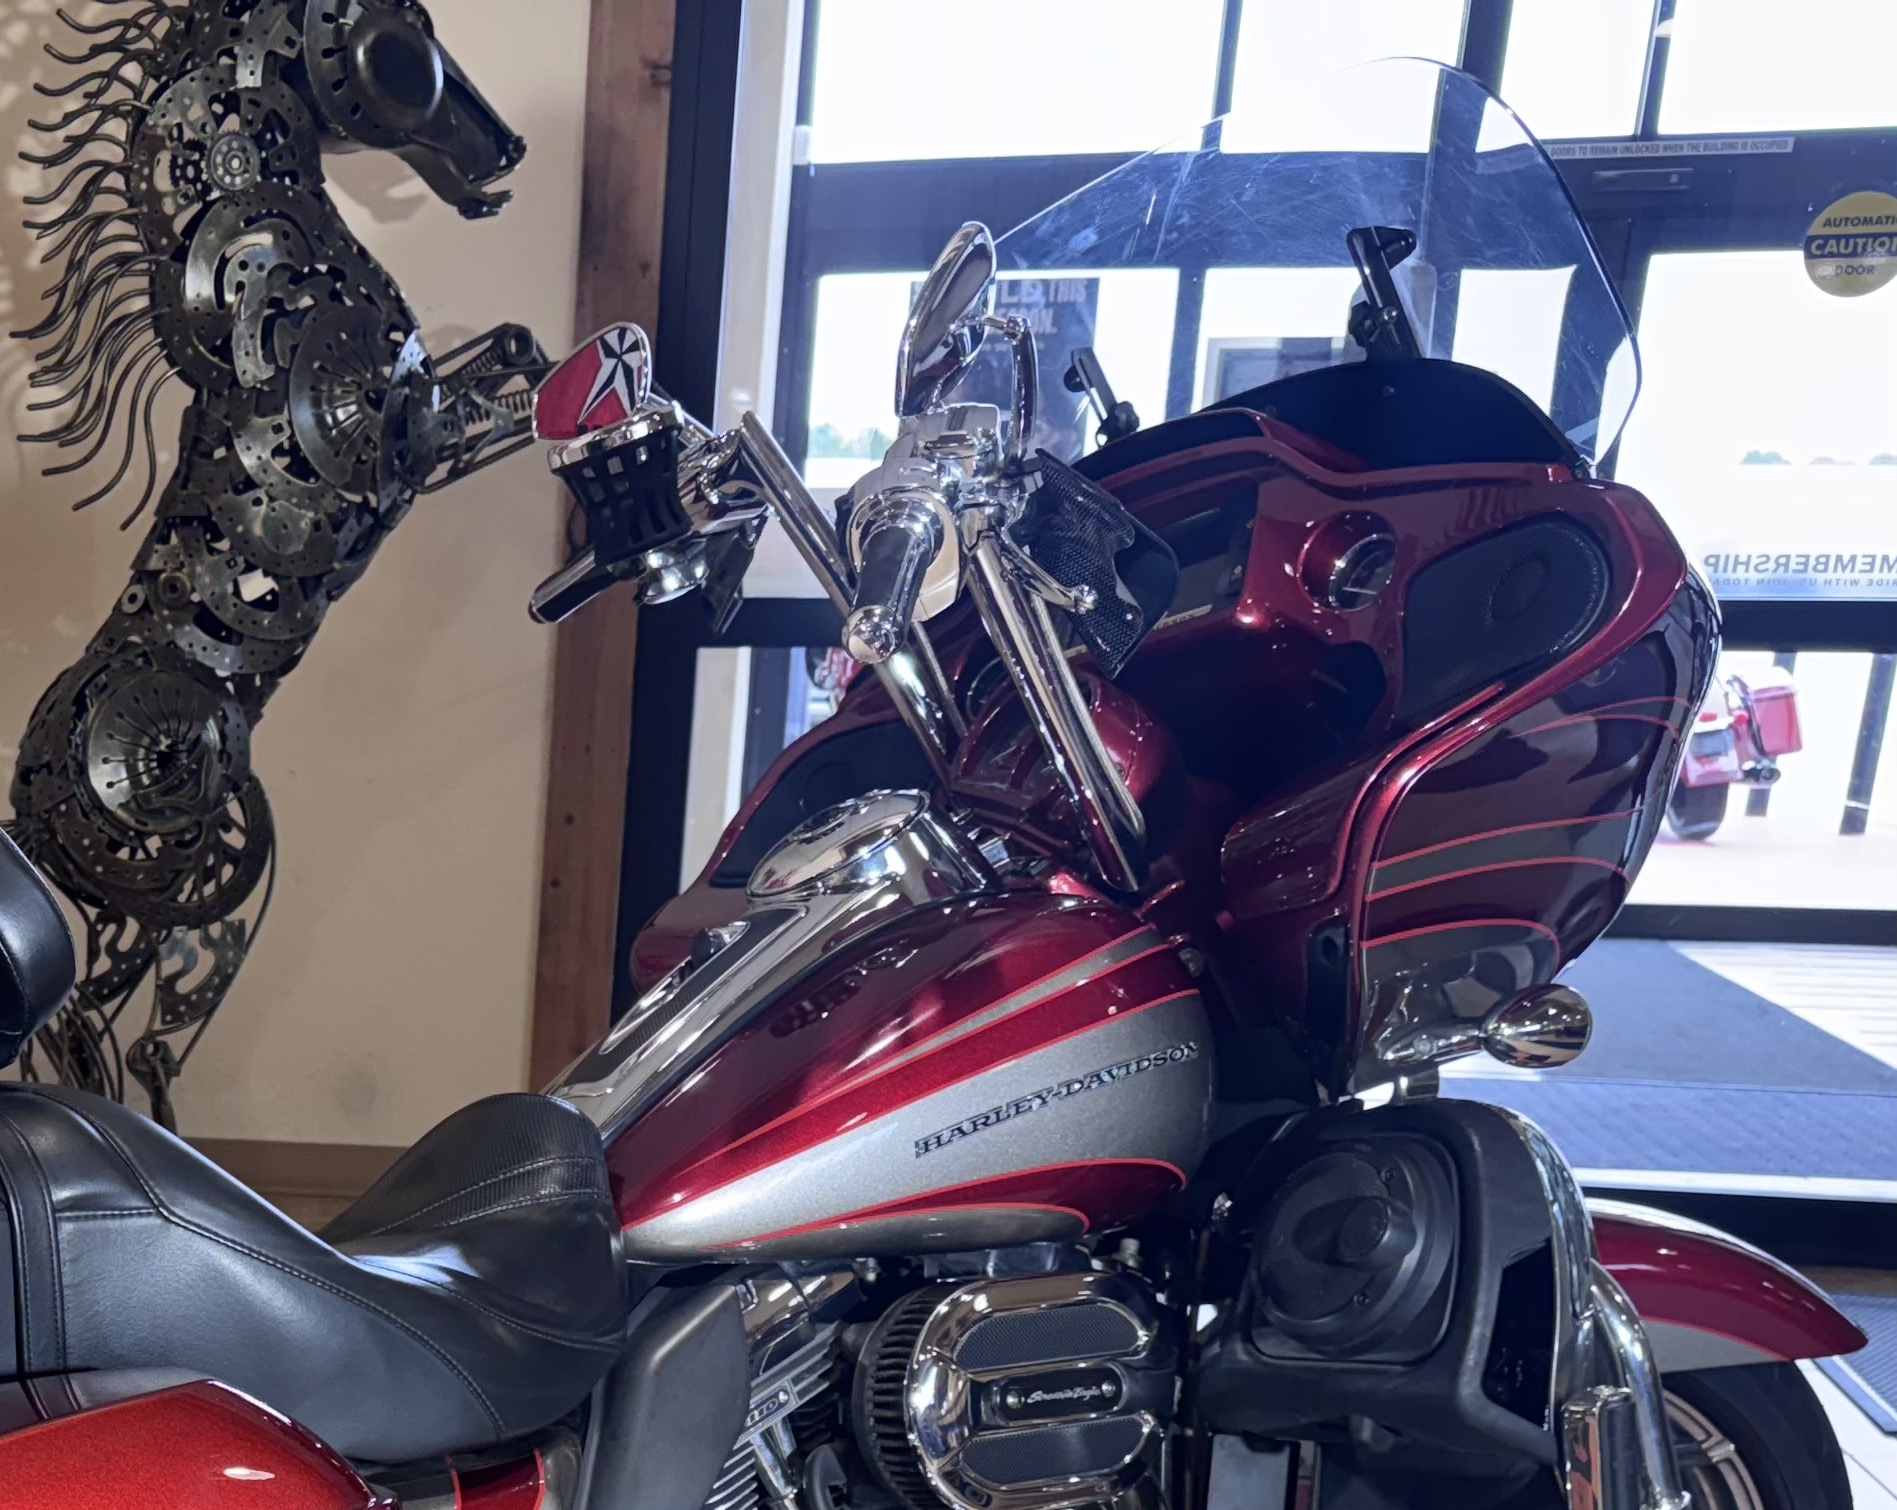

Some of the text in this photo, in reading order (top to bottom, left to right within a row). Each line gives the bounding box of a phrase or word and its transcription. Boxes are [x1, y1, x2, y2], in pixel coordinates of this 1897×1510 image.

[1823, 215, 1897, 228] AUTOMATI
[1836, 264, 1876, 276] DOOR
[914, 1041, 1199, 1158] HARLEY-DAVIDSON
